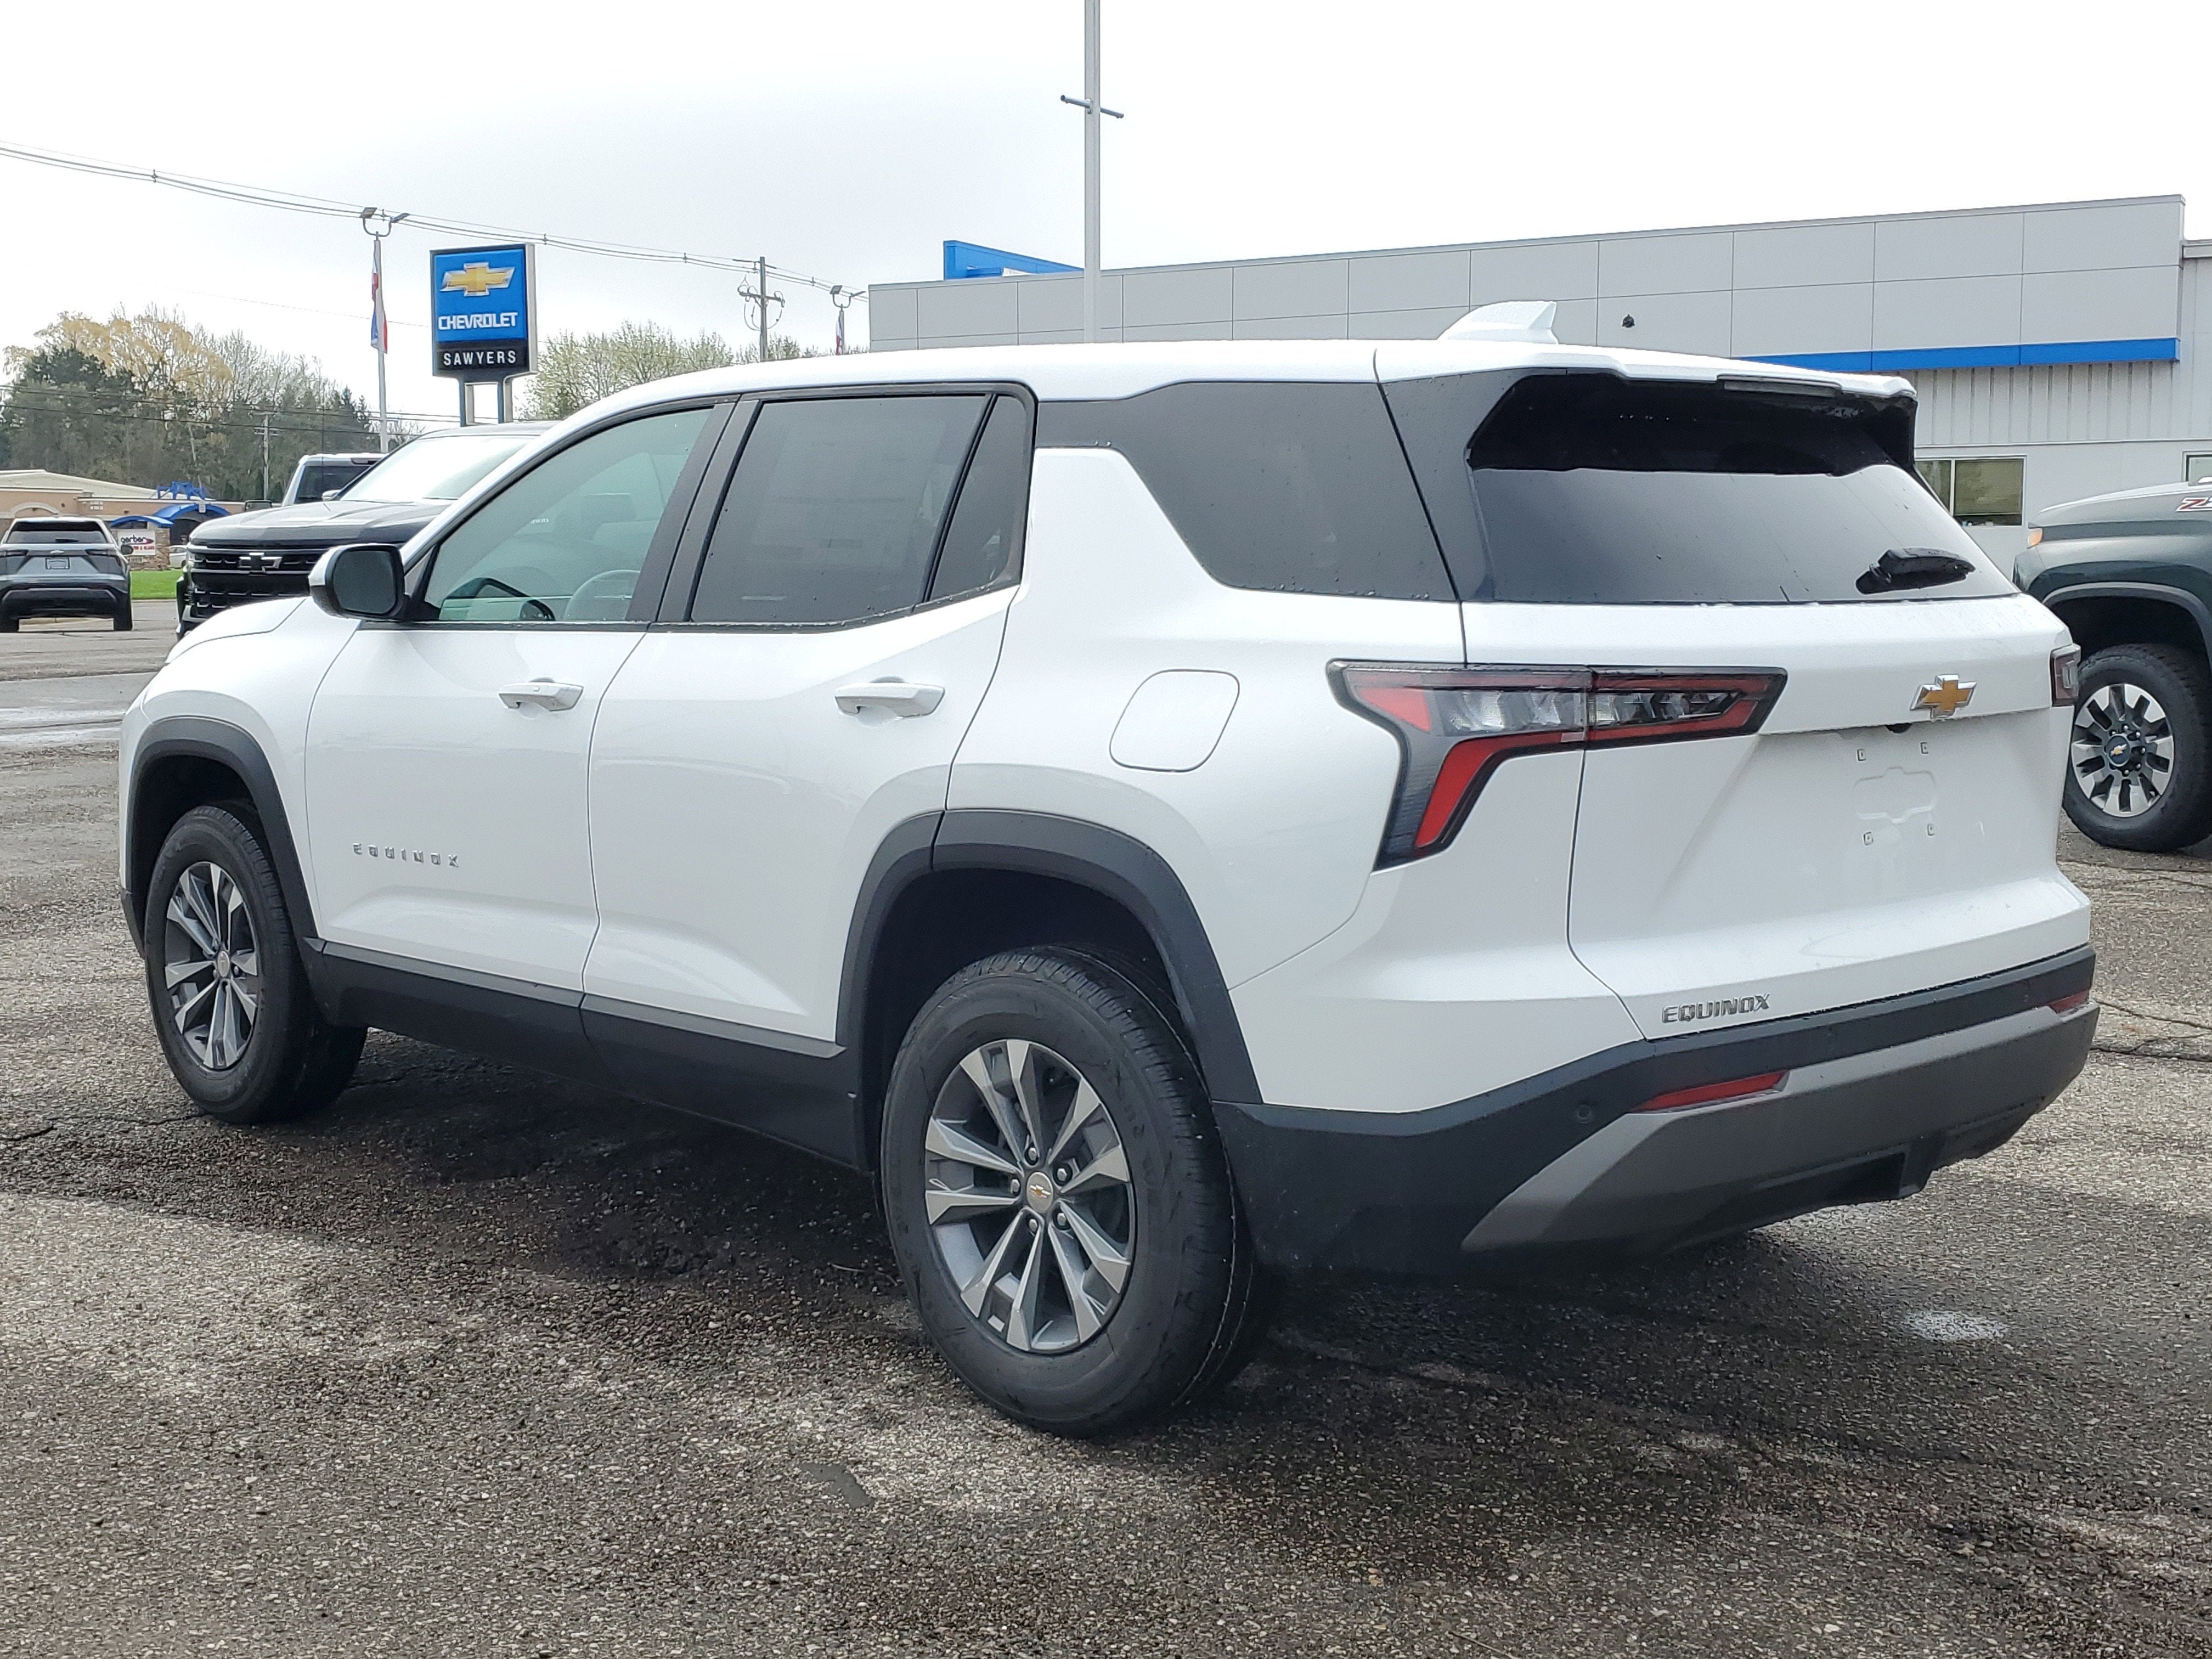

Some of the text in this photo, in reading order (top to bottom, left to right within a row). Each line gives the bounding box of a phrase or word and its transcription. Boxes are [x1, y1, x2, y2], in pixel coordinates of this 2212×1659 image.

[438, 312, 518, 330] CHEVROLET
[443, 350, 517, 366] SAWYERS
[121, 534, 146, 543] gerber
[353, 842, 459, 868] EQUINOX
[1662, 993, 1770, 1024] EQUINOX
